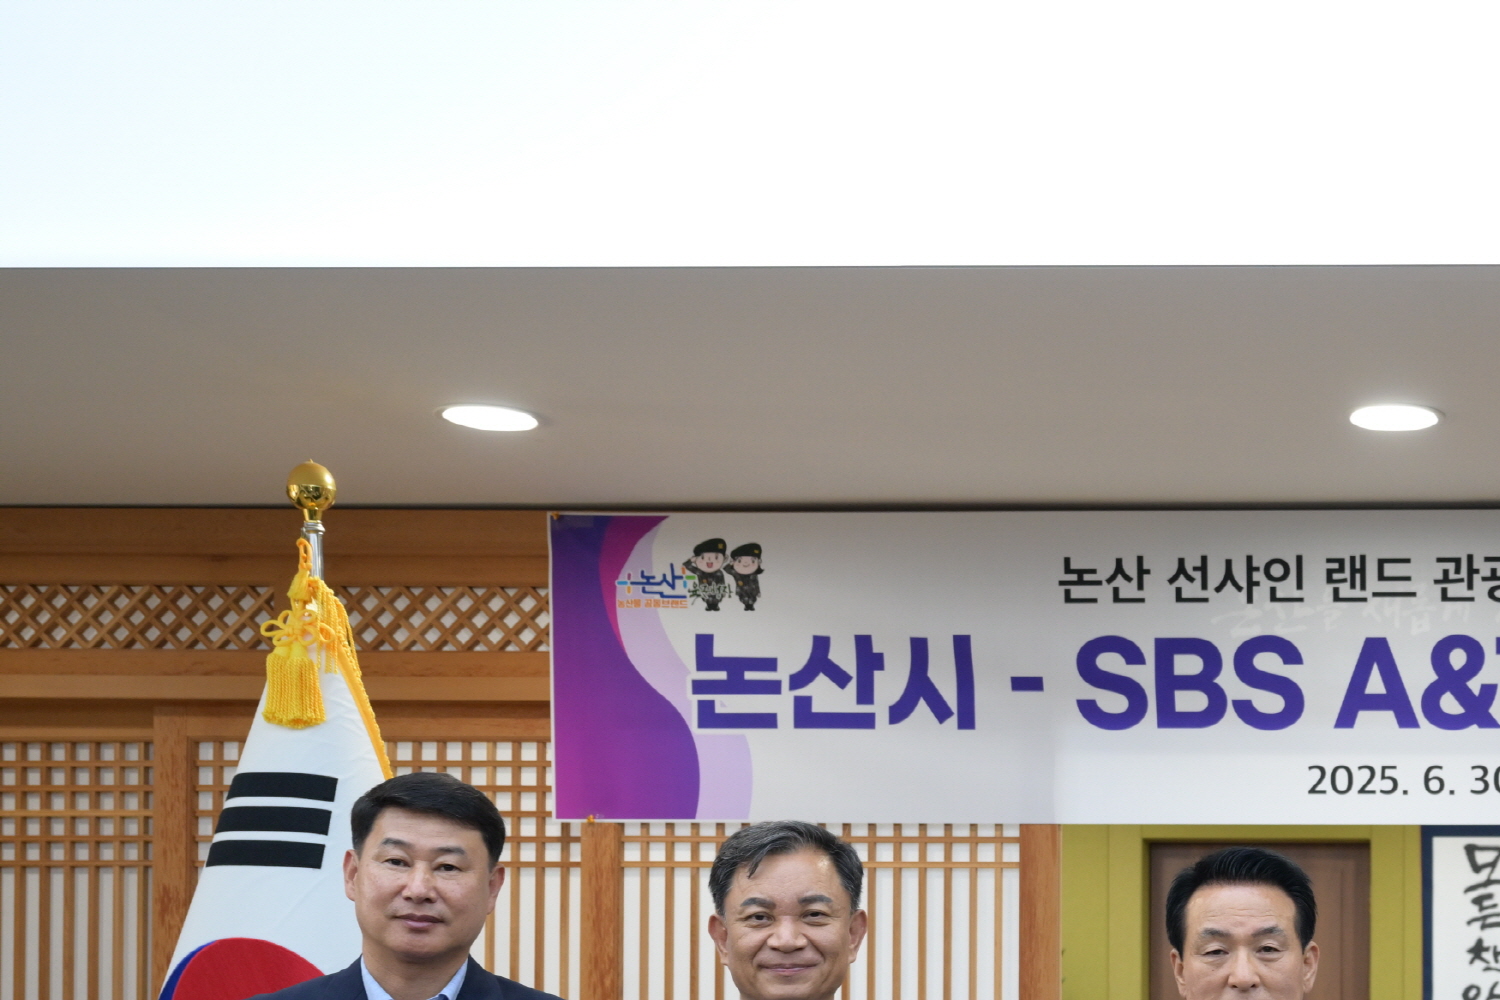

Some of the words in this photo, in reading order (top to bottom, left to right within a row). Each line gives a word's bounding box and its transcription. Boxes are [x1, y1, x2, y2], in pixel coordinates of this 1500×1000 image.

[1057, 554, 1151, 604] 논산
[1166, 554, 1306, 604] 선샤인
[1325, 554, 1417, 603] 랜드
[691, 633, 976, 730] 논산시
[1076, 634, 1305, 731] SBS
[1307, 764, 1409, 796] 2025.
[1423, 764, 1456, 796] 6.
